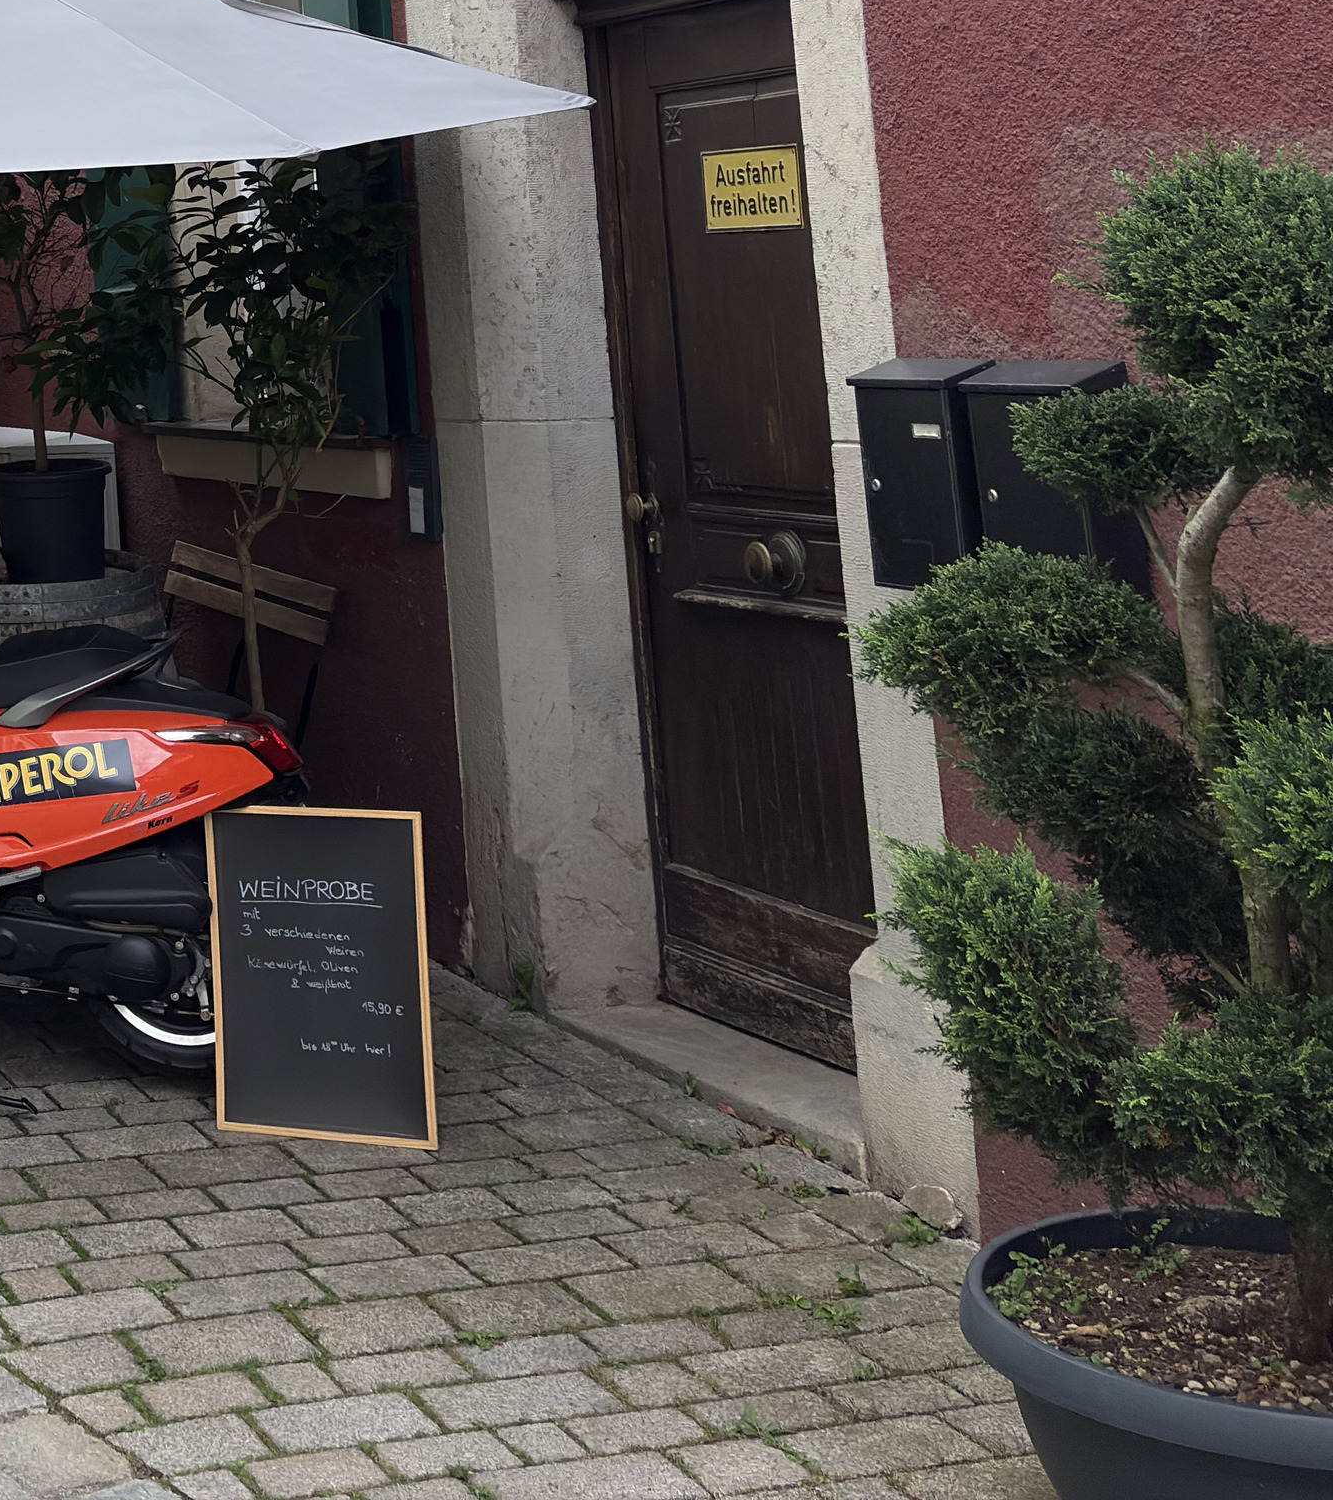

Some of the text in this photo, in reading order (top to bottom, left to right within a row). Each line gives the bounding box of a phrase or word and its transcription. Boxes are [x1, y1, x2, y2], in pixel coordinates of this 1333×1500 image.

[716, 160, 785, 187] Ausfahrt
[710, 188, 797, 218] freihalten!
[147, 815, 173, 830] Kern
[242, 907, 261, 920] mit
[240, 923, 351, 941] 3 verschiedenen
[362, 1001, 405, 1016] 15,90 €
